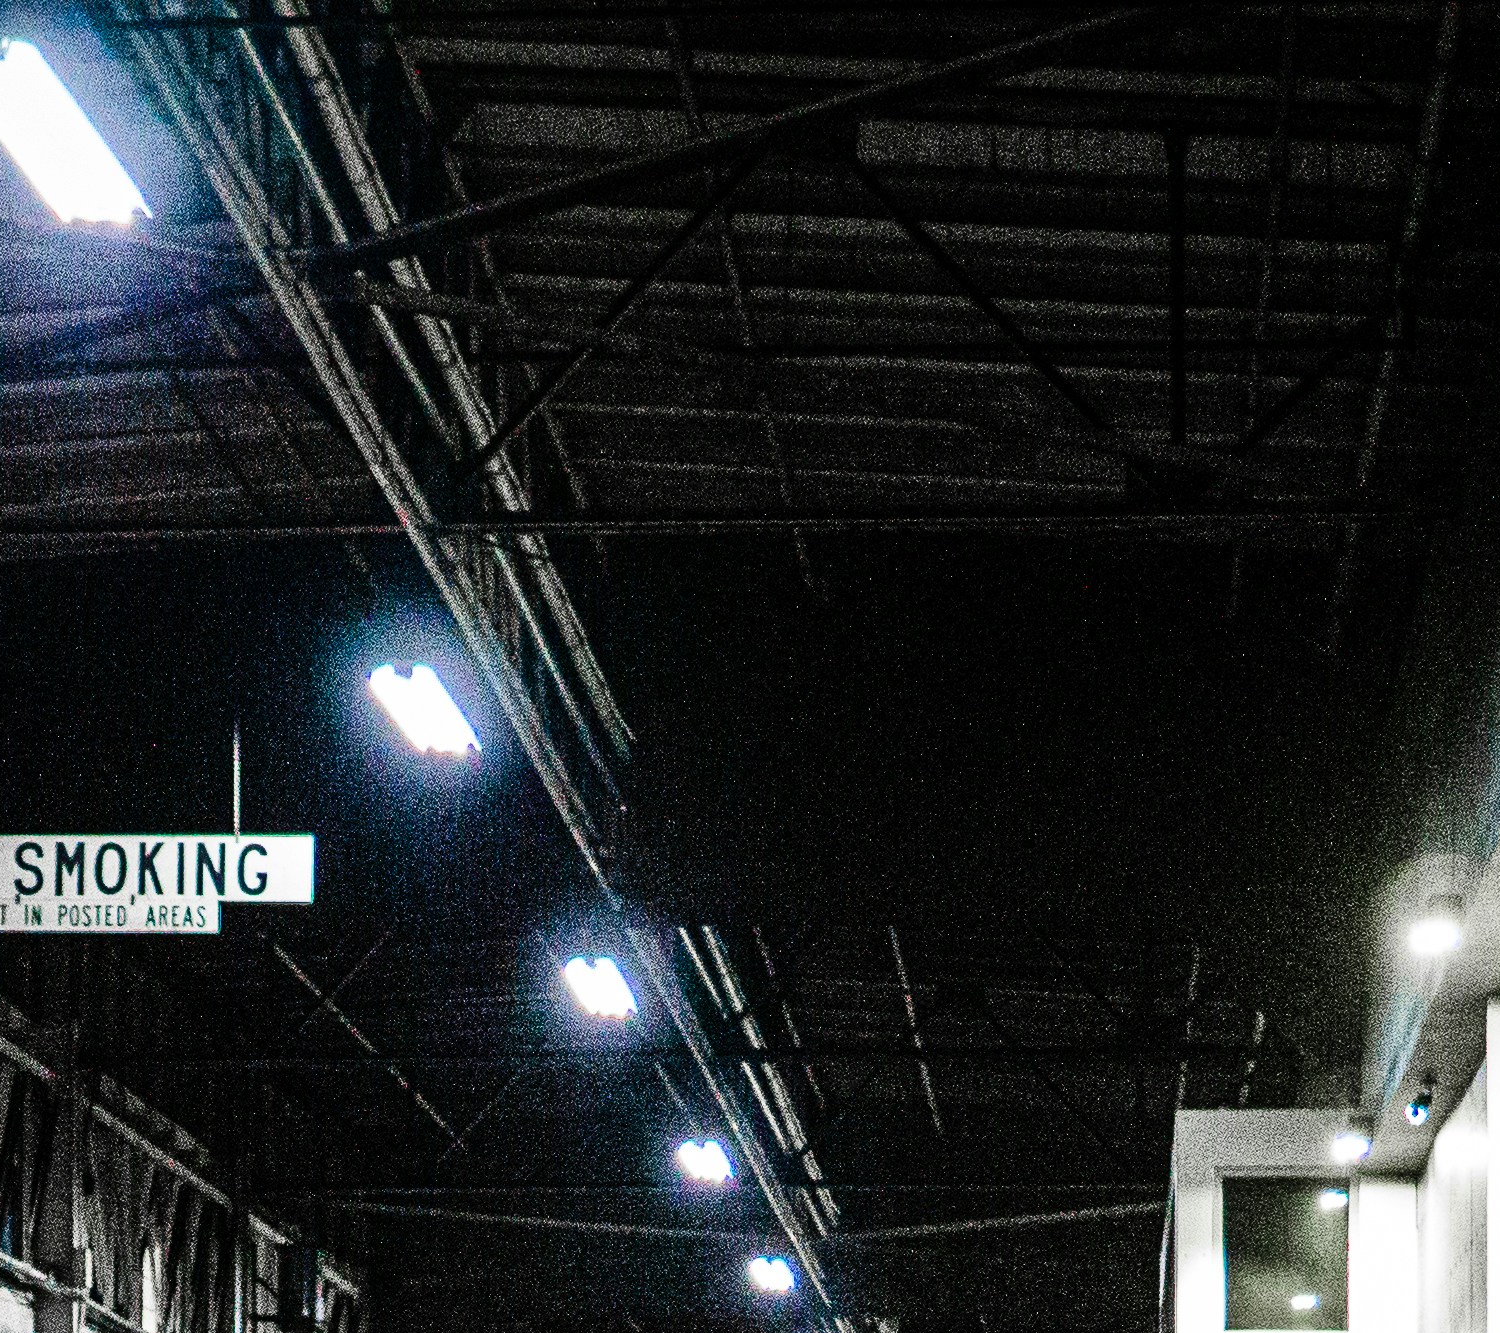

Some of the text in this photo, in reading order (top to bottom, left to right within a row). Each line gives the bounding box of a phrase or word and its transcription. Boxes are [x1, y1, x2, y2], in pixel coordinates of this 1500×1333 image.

[12, 840, 270, 896] SMOKING
[24, 904, 41, 925] IN
[57, 905, 128, 926] POSTED
[145, 905, 207, 927] AREAS
